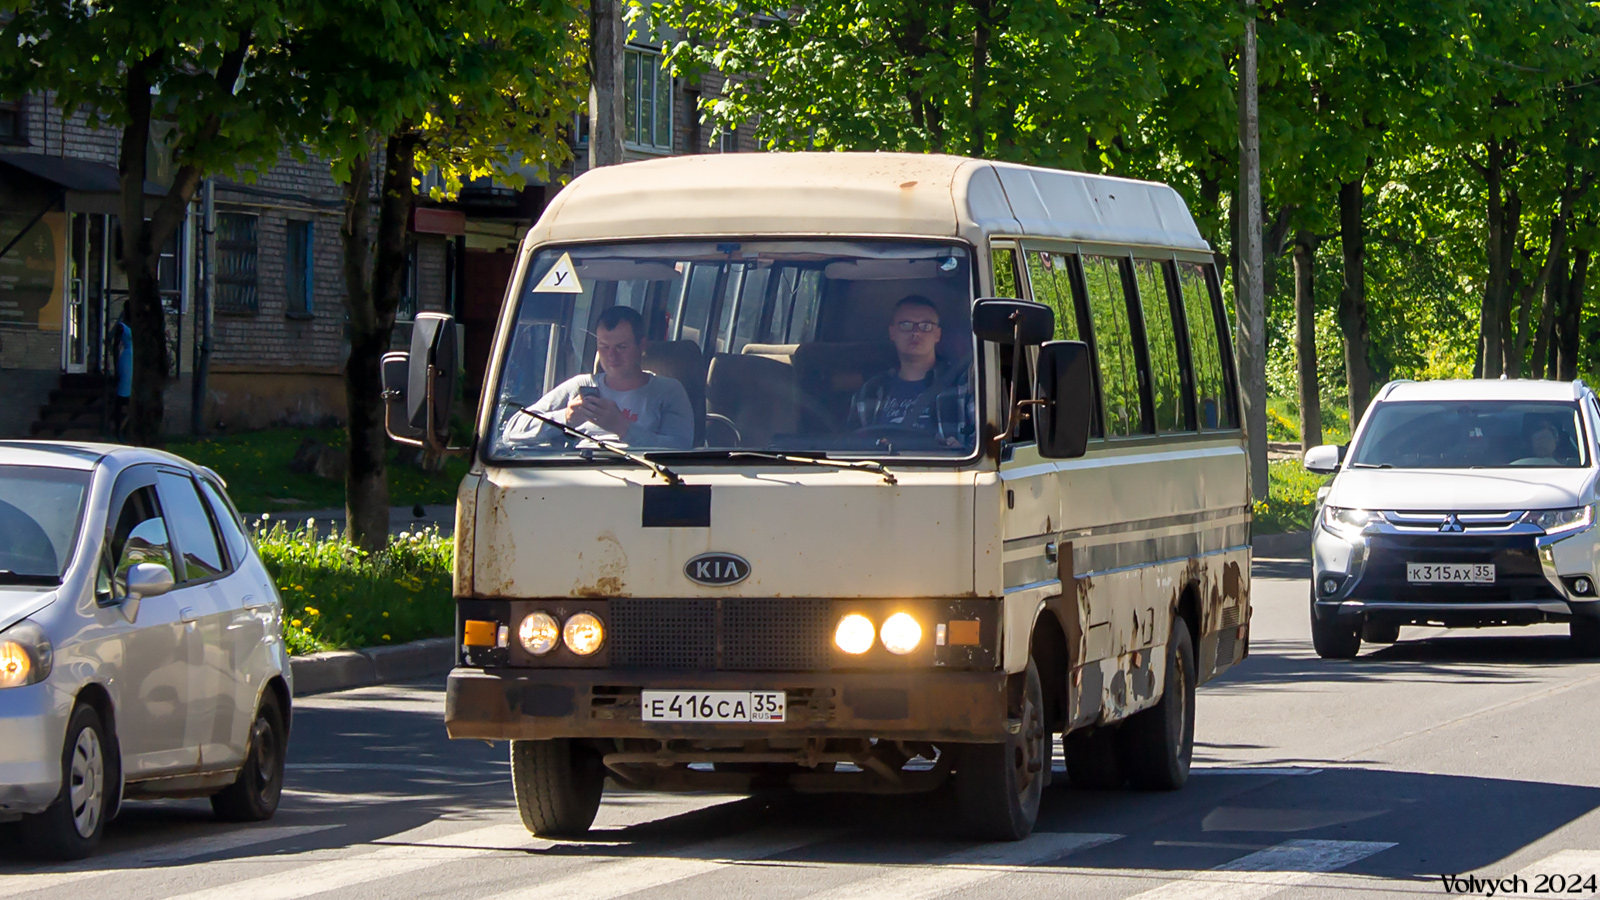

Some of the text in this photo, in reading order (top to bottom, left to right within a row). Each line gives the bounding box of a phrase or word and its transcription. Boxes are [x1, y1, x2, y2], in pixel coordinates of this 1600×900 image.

[696, 561, 739, 578] KIA
[1413, 565, 1490, 580] К315АХ 35
[651, 694, 777, 718] Е416СА 35
[752, 712, 769, 720] RUS
